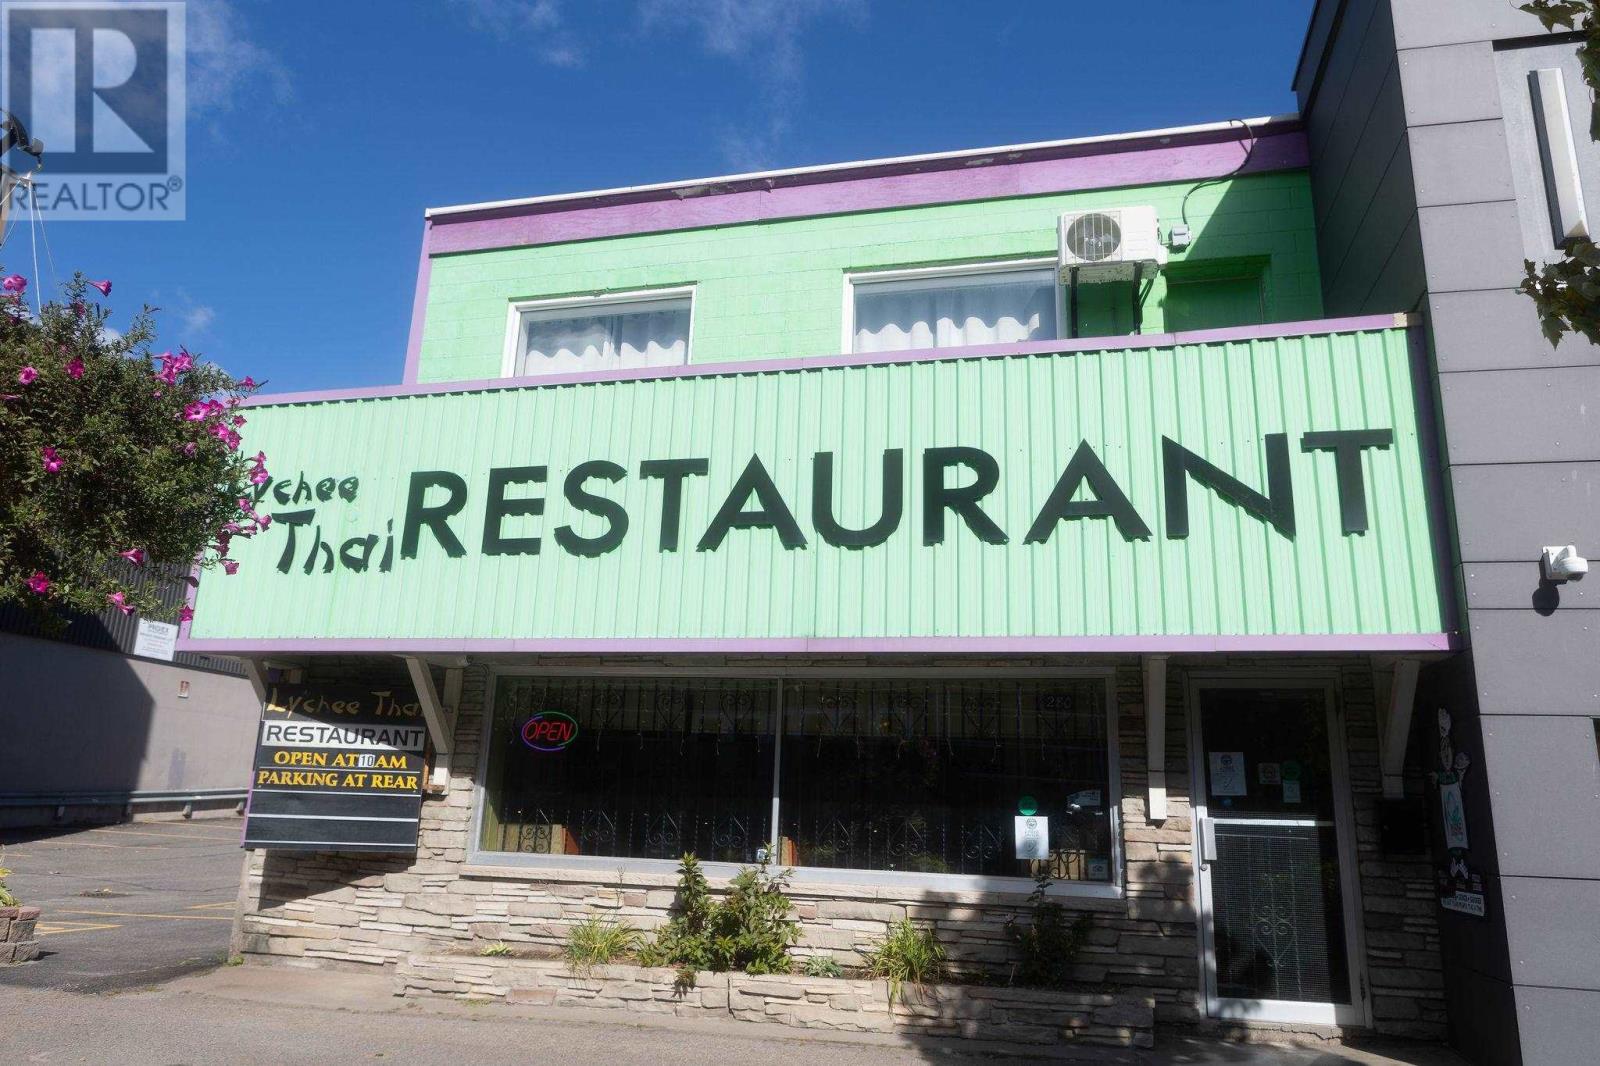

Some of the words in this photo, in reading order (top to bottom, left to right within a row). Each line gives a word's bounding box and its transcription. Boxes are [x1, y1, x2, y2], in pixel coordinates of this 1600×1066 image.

[244, 471, 359, 509] ychee
[272, 509, 394, 575] Thai
[401, 428, 1394, 560] RESTAURANT
[266, 687, 361, 719] Lychee
[371, 691, 424, 717] Tha
[266, 724, 424, 747] RESTAURANT
[525, 721, 574, 741] OPEN
[274, 751, 327, 767] OPEN
[331, 754, 359, 768] AT
[360, 755, 374, 768] 10
[374, 755, 407, 769] AM
[257, 770, 338, 787] PARKING
[342, 773, 367, 788] AT
[371, 775, 418, 790] REAR
